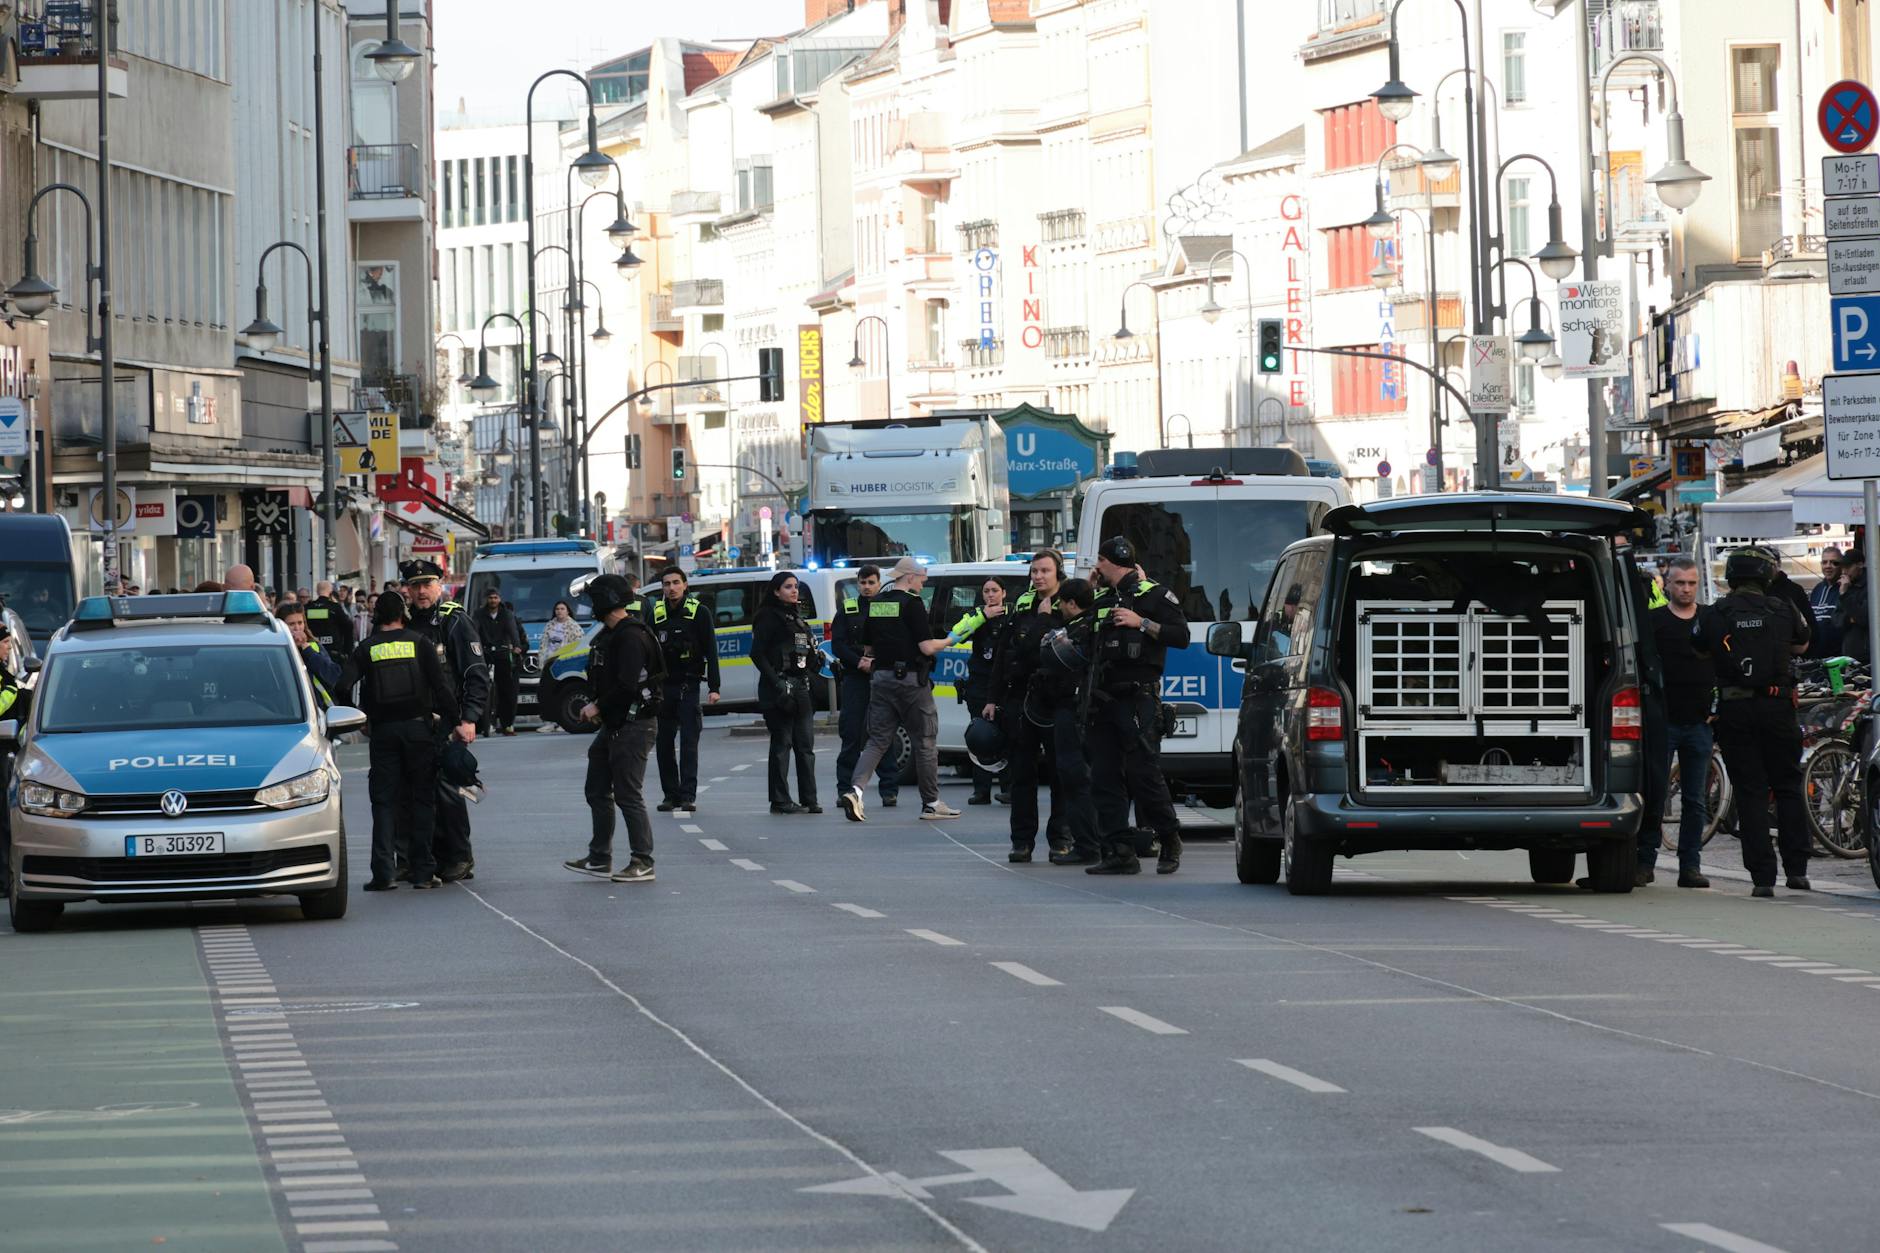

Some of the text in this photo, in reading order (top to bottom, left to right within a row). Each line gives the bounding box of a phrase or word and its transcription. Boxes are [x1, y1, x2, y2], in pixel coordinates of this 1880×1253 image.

[1835, 161, 1866, 176] Mo-Fr
[1837, 178, 1868, 192] 7-17 h
[1837, 204, 1868, 217] auf dem
[1828, 216, 1879, 231] Seitenstreifen
[1844, 275, 1868, 286] erlaubt
[1022, 244, 1042, 349] KINO
[1578, 284, 1621, 298] Werbe
[975, 248, 996, 350] OPER
[1280, 194, 1305, 407] GALERIE
[1560, 297, 1617, 310] monitore
[1606, 307, 1623, 319] ab
[1839, 306, 1869, 362] P
[1472, 337, 1496, 348] Kann
[800, 330, 821, 379] FUCHS
[1491, 347, 1506, 360] weg
[1472, 392, 1504, 403] bleiben
[1830, 395, 1876, 406] mit Parkschein
[371, 429, 391, 440] DE
[1838, 431, 1850, 442] für
[1853, 430, 1874, 441] Zone
[1016, 432, 1036, 457] U
[1356, 448, 1381, 458] RIX
[1838, 448, 1863, 459] Mo-Fr
[1007, 458, 1079, 472] Marx-Straße
[851, 481, 935, 493] HUBER LOGISTIK
[1736, 619, 1763, 628] POLIZEI
[108, 754, 237, 771] POLIZEI
[144, 835, 216, 853] B 30392
